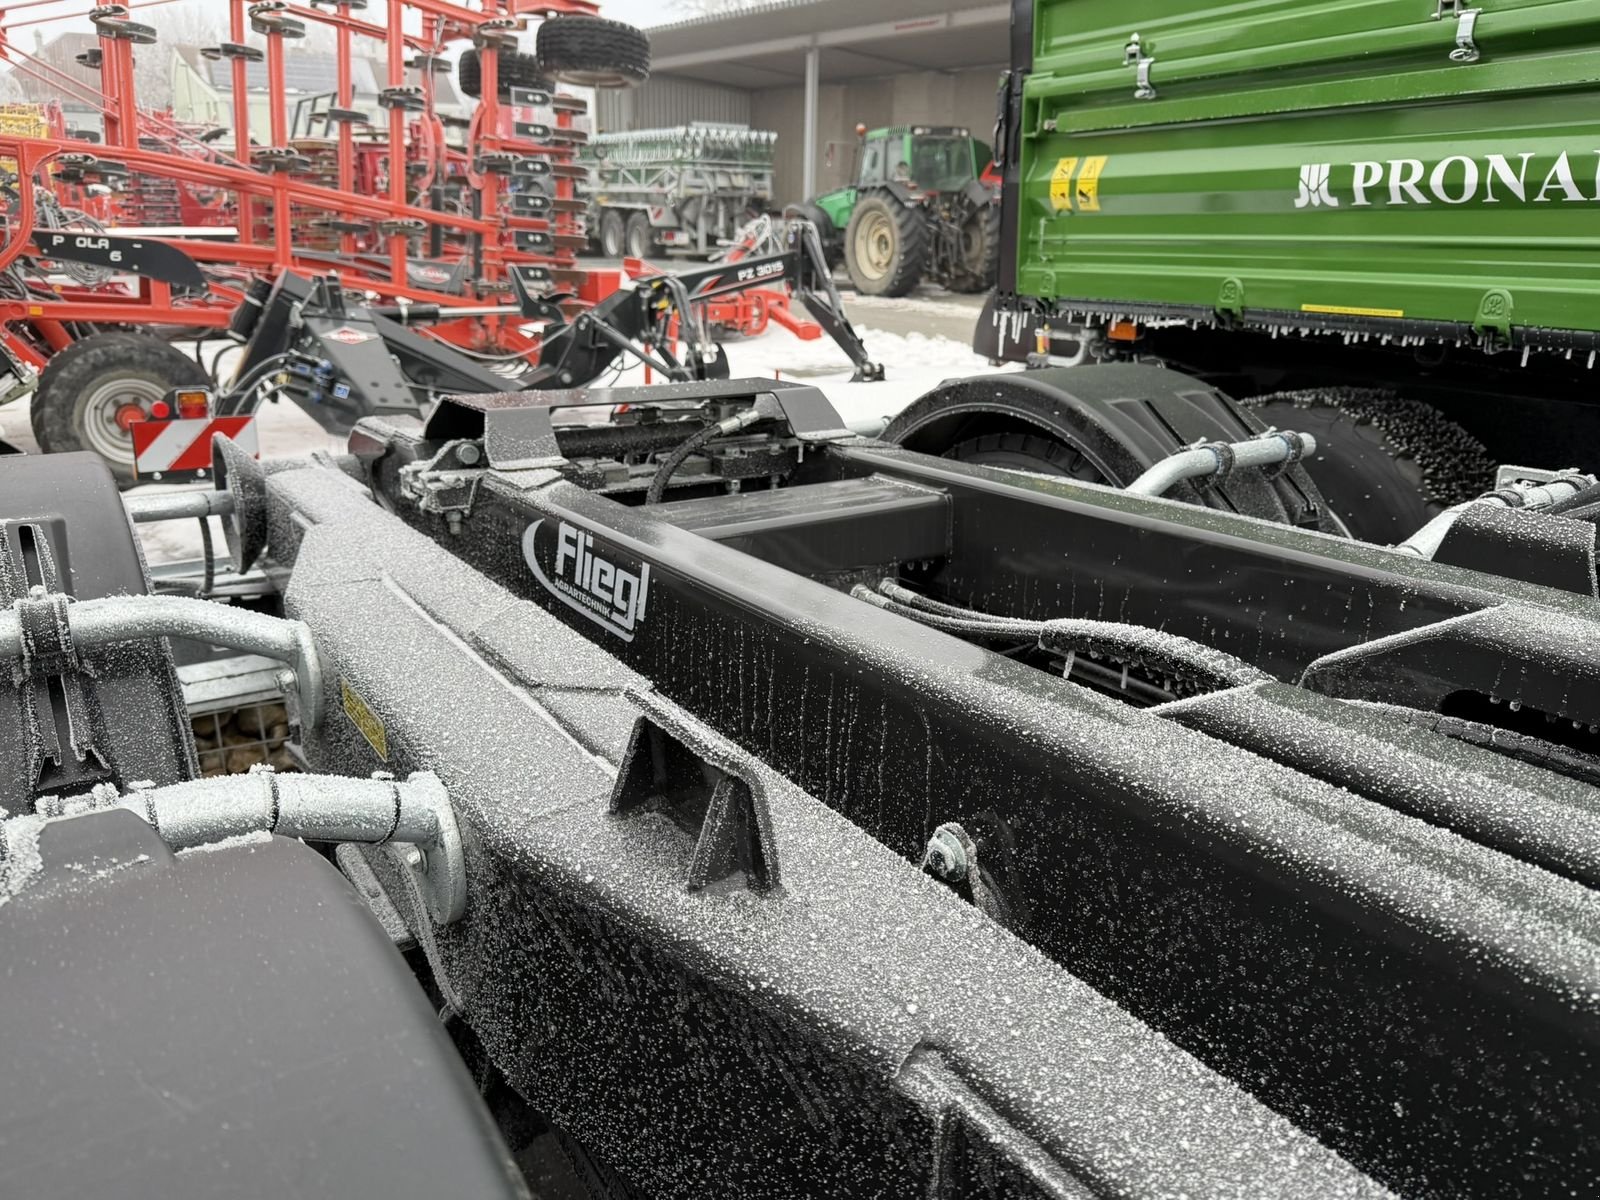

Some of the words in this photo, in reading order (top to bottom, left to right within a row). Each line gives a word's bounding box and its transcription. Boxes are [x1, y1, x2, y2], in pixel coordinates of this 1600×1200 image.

[737, 267, 755, 281] PZ
[756, 261, 784, 277] 3015
[555, 521, 650, 631] Fliegl
[553, 578, 612, 619] AGRARTECHNIK
